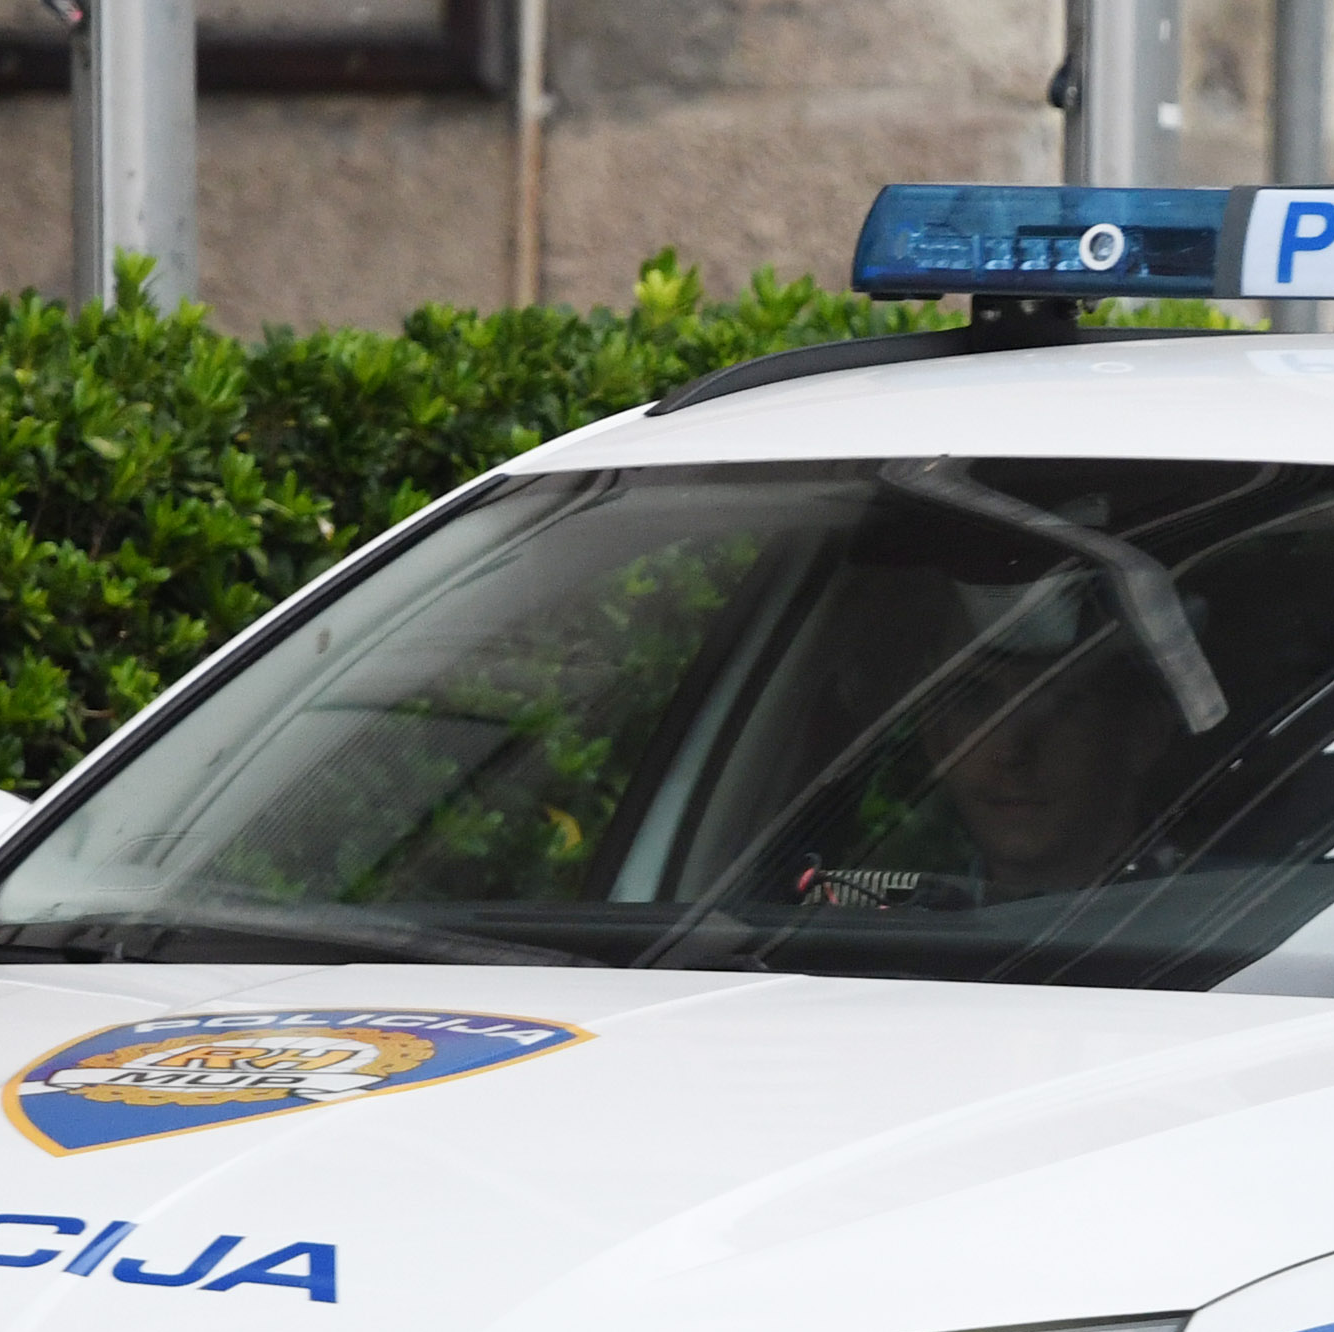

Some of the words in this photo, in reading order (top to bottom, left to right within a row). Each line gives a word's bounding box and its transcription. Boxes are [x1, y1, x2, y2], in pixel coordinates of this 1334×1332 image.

[133, 1013, 556, 1046] POLICIJA
[156, 1047, 356, 1070] RH
[114, 1069, 305, 1088] MUP
